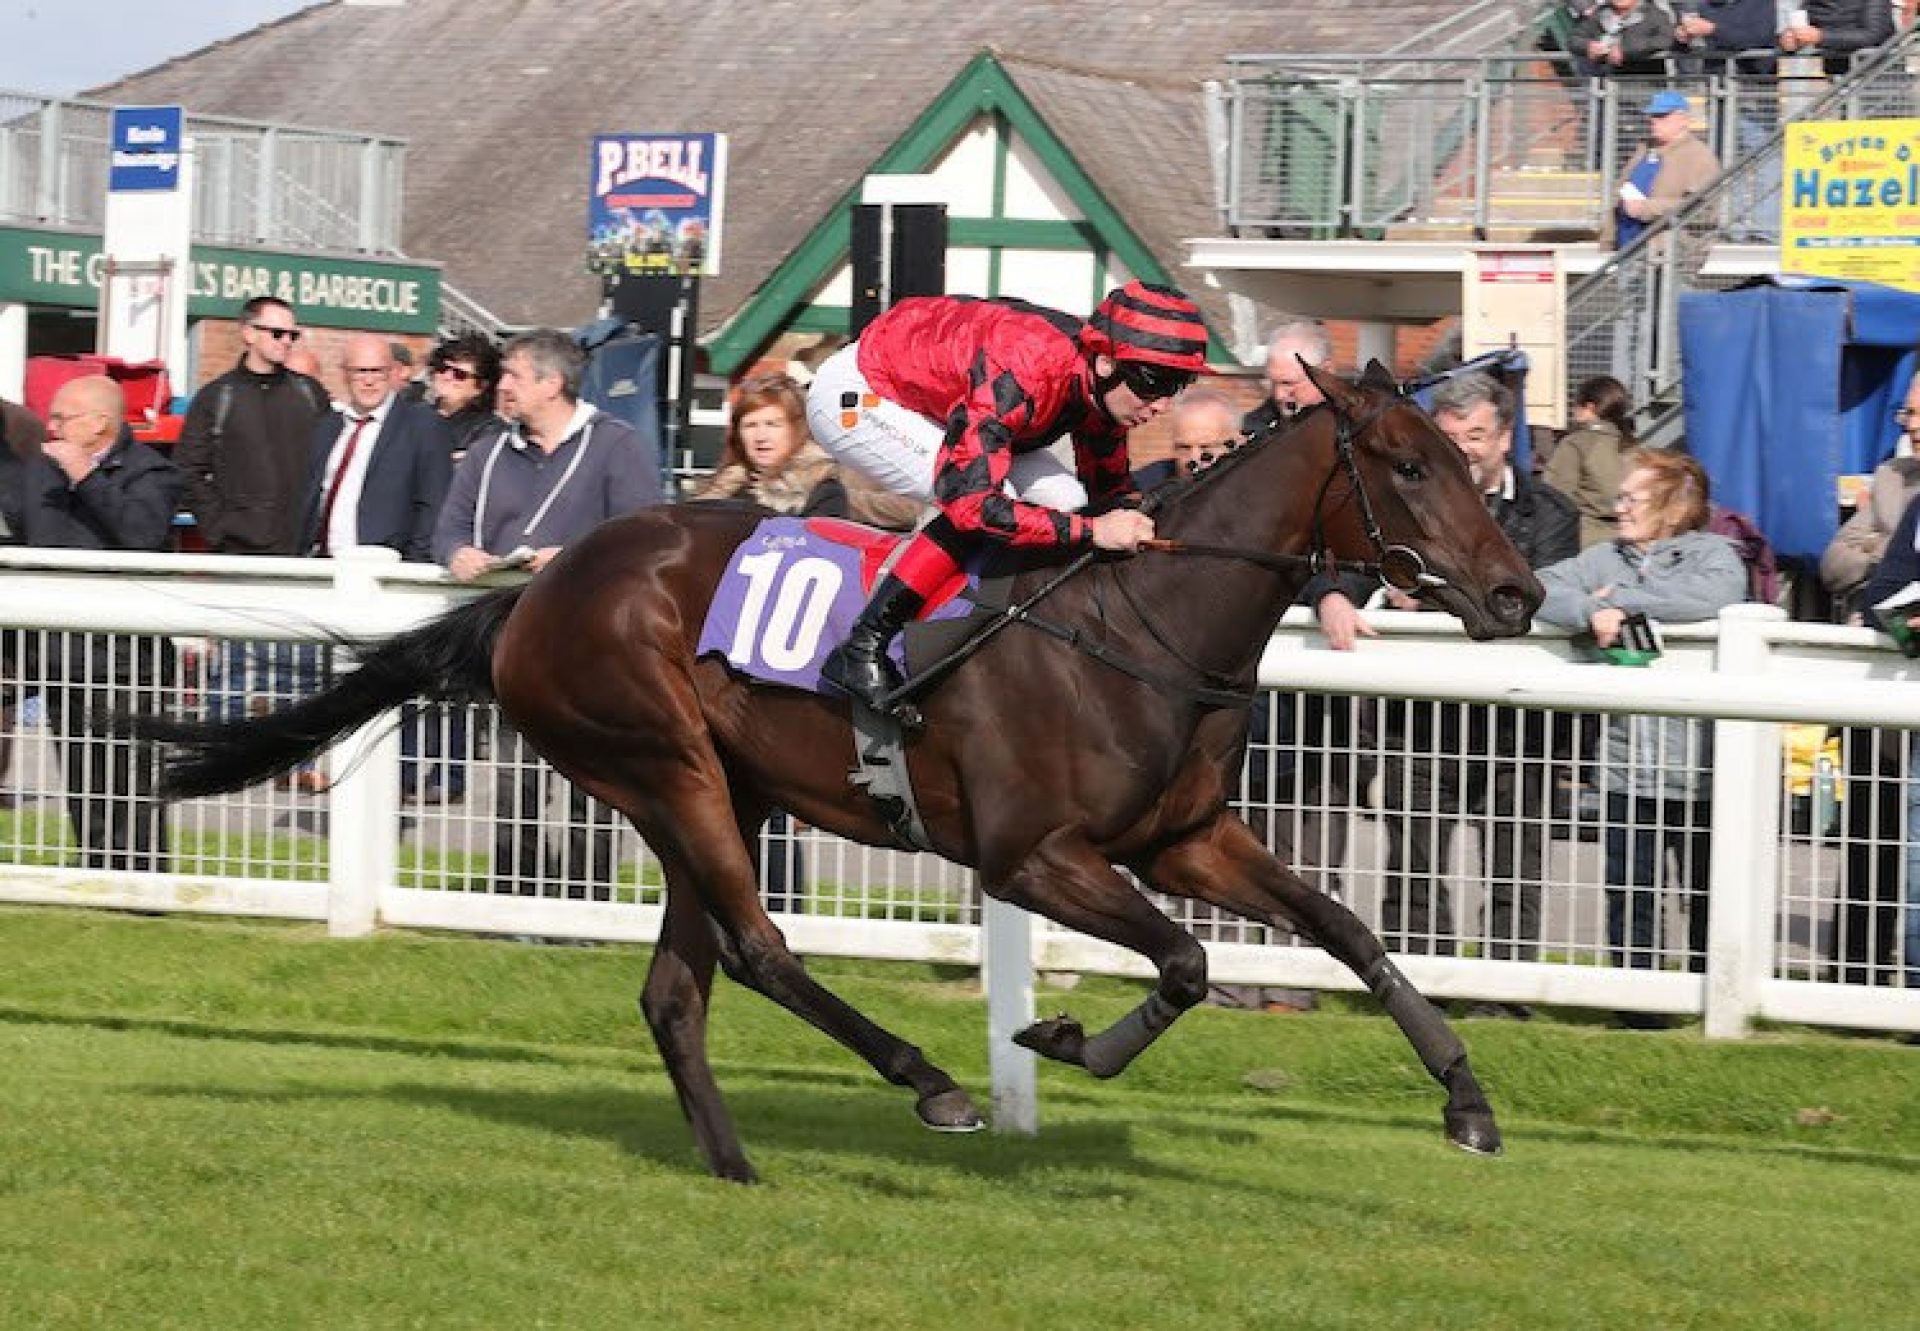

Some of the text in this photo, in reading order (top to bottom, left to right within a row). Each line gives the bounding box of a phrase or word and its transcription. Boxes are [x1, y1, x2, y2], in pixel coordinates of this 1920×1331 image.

[27, 247, 82, 286] THE
[223, 265, 270, 299] BAR
[275, 271, 295, 303] &
[299, 271, 419, 316] BARBECUE
[727, 550, 844, 672] 10
